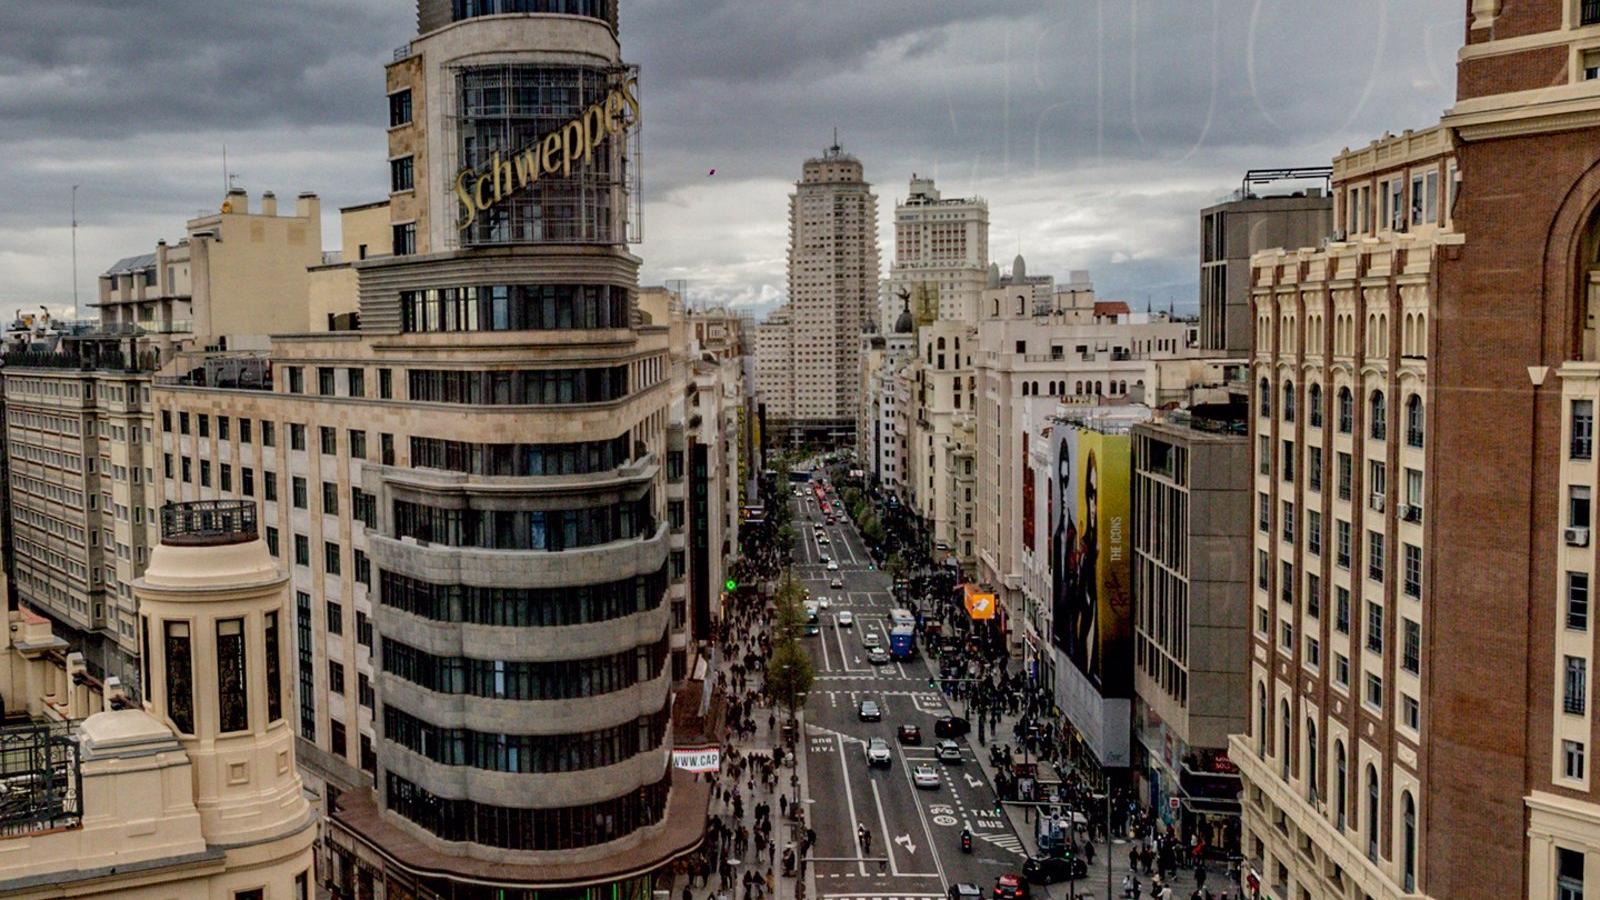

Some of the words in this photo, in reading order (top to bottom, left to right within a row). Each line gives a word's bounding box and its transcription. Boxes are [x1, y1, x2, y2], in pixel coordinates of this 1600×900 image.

[455, 78, 641, 232] Schweppes
[696, 466, 706, 548] HOTEL
[1111, 545, 1122, 562] THE
[977, 820, 1004, 828] BUS
